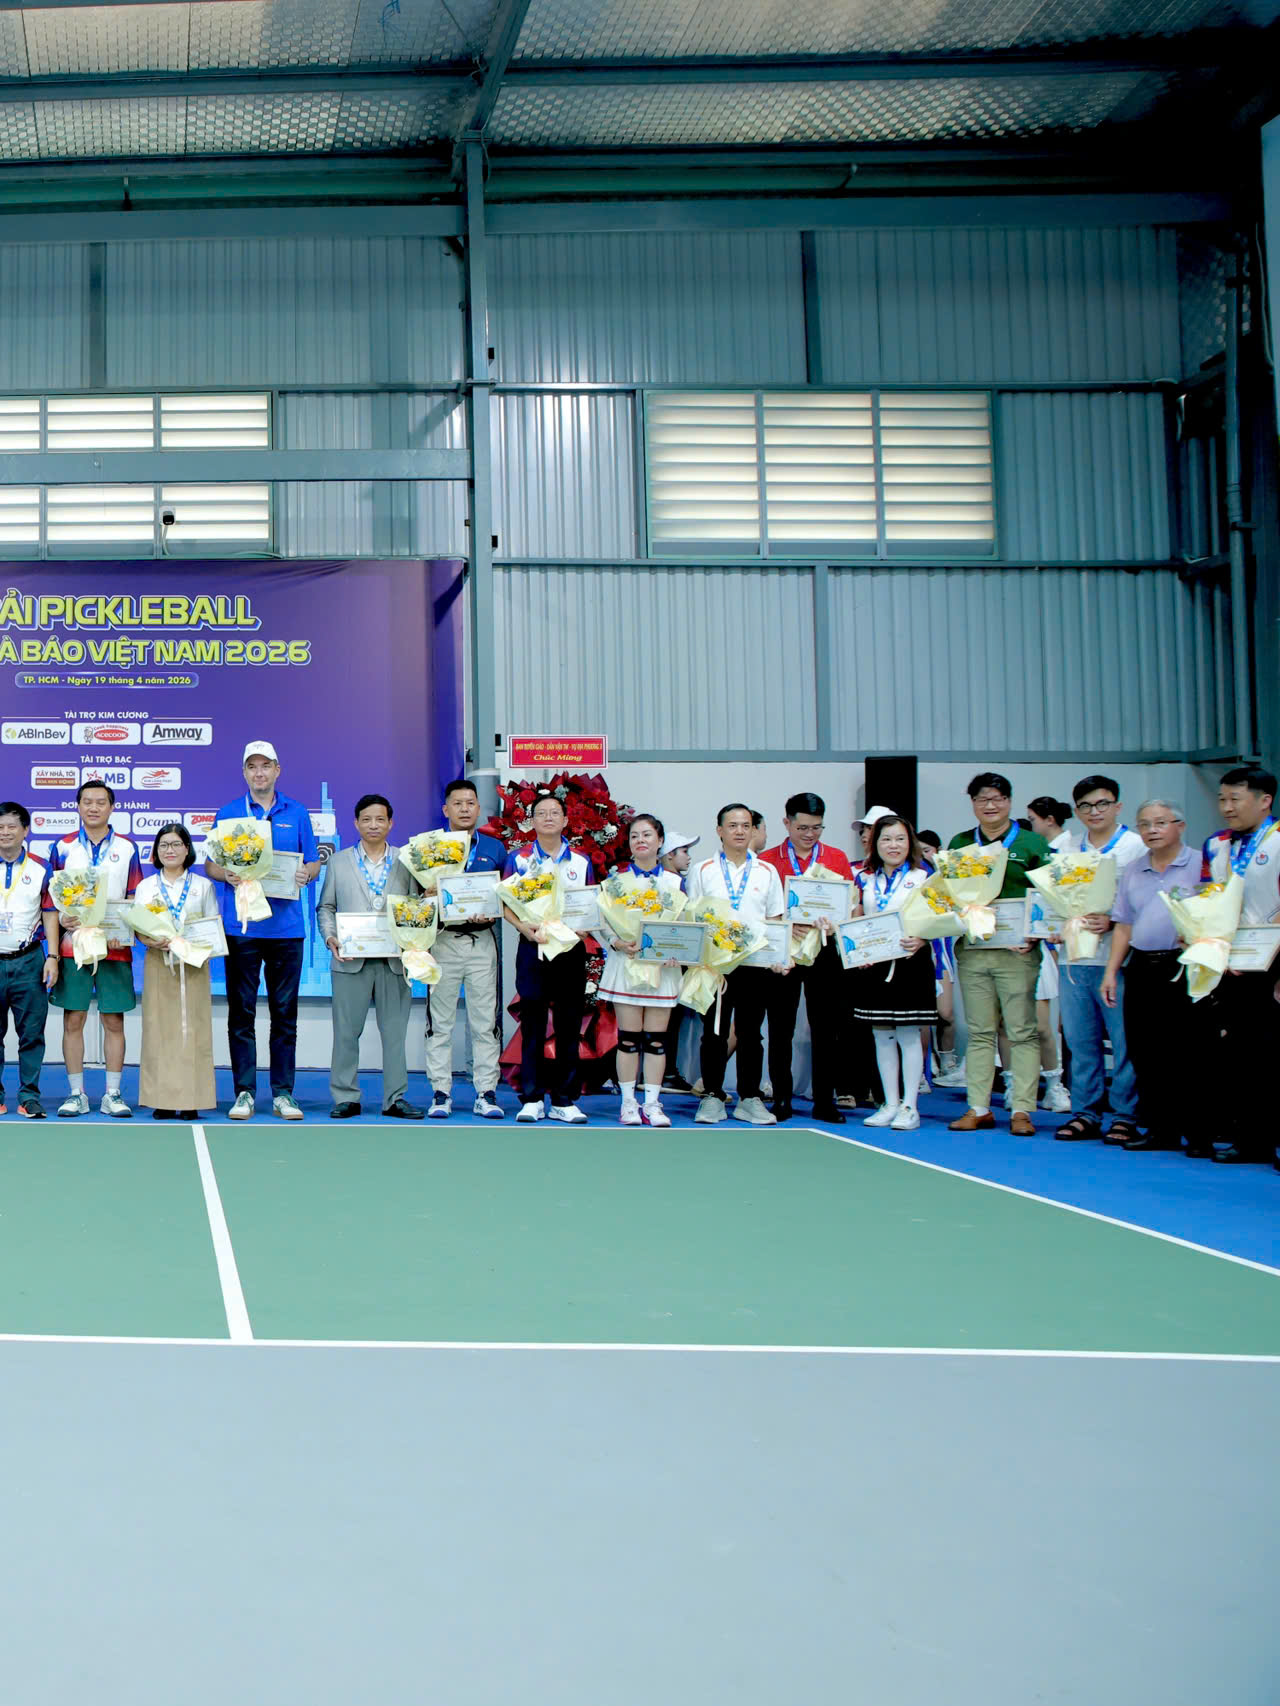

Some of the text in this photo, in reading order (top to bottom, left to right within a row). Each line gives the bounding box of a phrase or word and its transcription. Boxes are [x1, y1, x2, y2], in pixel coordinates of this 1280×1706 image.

[39, 596, 259, 628] PICKLEBALL
[22, 635, 85, 663] BÁO
[87, 636, 150, 667] VIỆT
[154, 641, 221, 663] NAM
[226, 641, 310, 664] 2026
[24, 676, 36, 684] TP.
[38, 676, 59, 684] HCM
[67, 676, 92, 686] Ngày
[108, 676, 134, 686] tháng
[145, 676, 164, 684] năm
[168, 676, 191, 684] 2026
[64, 710, 78, 719] TÀI
[79, 711, 96, 720] TRỢ
[117, 711, 149, 720] CƯƠNG
[18, 728, 66, 740] ABInBev
[152, 724, 203, 740] Amway
[80, 755, 132, 766] TÀI TRỢ BẠC
[104, 773, 126, 784] MB
[124, 801, 150, 810] HÀNH
